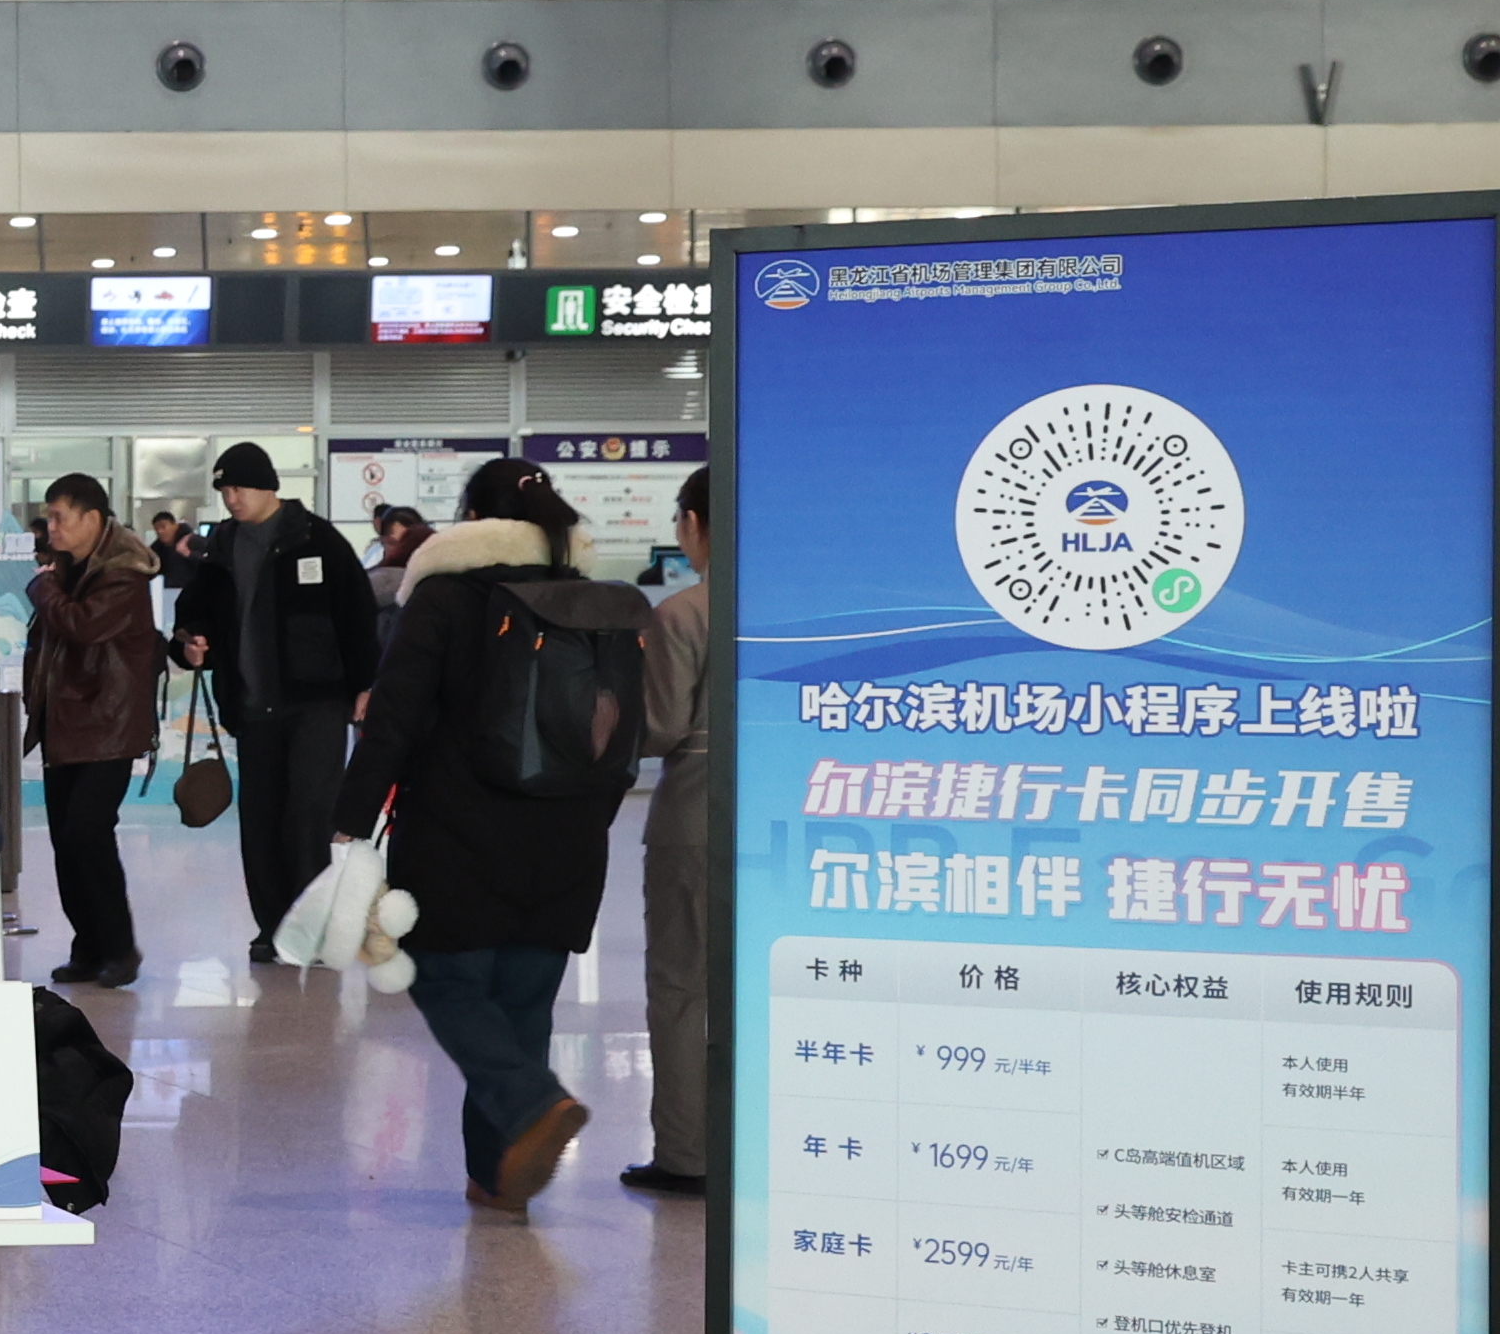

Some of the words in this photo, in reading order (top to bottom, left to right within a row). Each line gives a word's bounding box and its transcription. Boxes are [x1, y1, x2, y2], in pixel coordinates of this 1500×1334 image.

[828, 254, 1124, 289] 黑龙江省机场管理集团有限公司
[1061, 531, 1135, 554] HLJA
[799, 681, 1421, 739] 哈尔滨机场小程序上线啦
[801, 758, 1415, 831] 尔滨捷行卡同步开售
[808, 847, 1082, 918] 尔滨相伴
[1106, 856, 1412, 934] 捷行无忧
[1115, 970, 1231, 1001] 核心权益
[1294, 978, 1414, 1010] 使用规则
[794, 1038, 875, 1068] 半年卡
[1280, 1053, 1349, 1074] 本人使用
[1280, 1080, 1367, 1103] 有效期半年
[1113, 1143, 1246, 1173] C岛高端值机区域
[1280, 1157, 1349, 1178] 本人使用
[1280, 1183, 1366, 1207] 有效期一年
[1113, 1199, 1235, 1229] 头等舱安检通道
[793, 1228, 874, 1259] 家庭卡
[1113, 1255, 1218, 1285] 头等舱休息室
[1280, 1258, 1410, 1286] 卡主可携2人共享
[1280, 1285, 1366, 1309] 有效期一年
